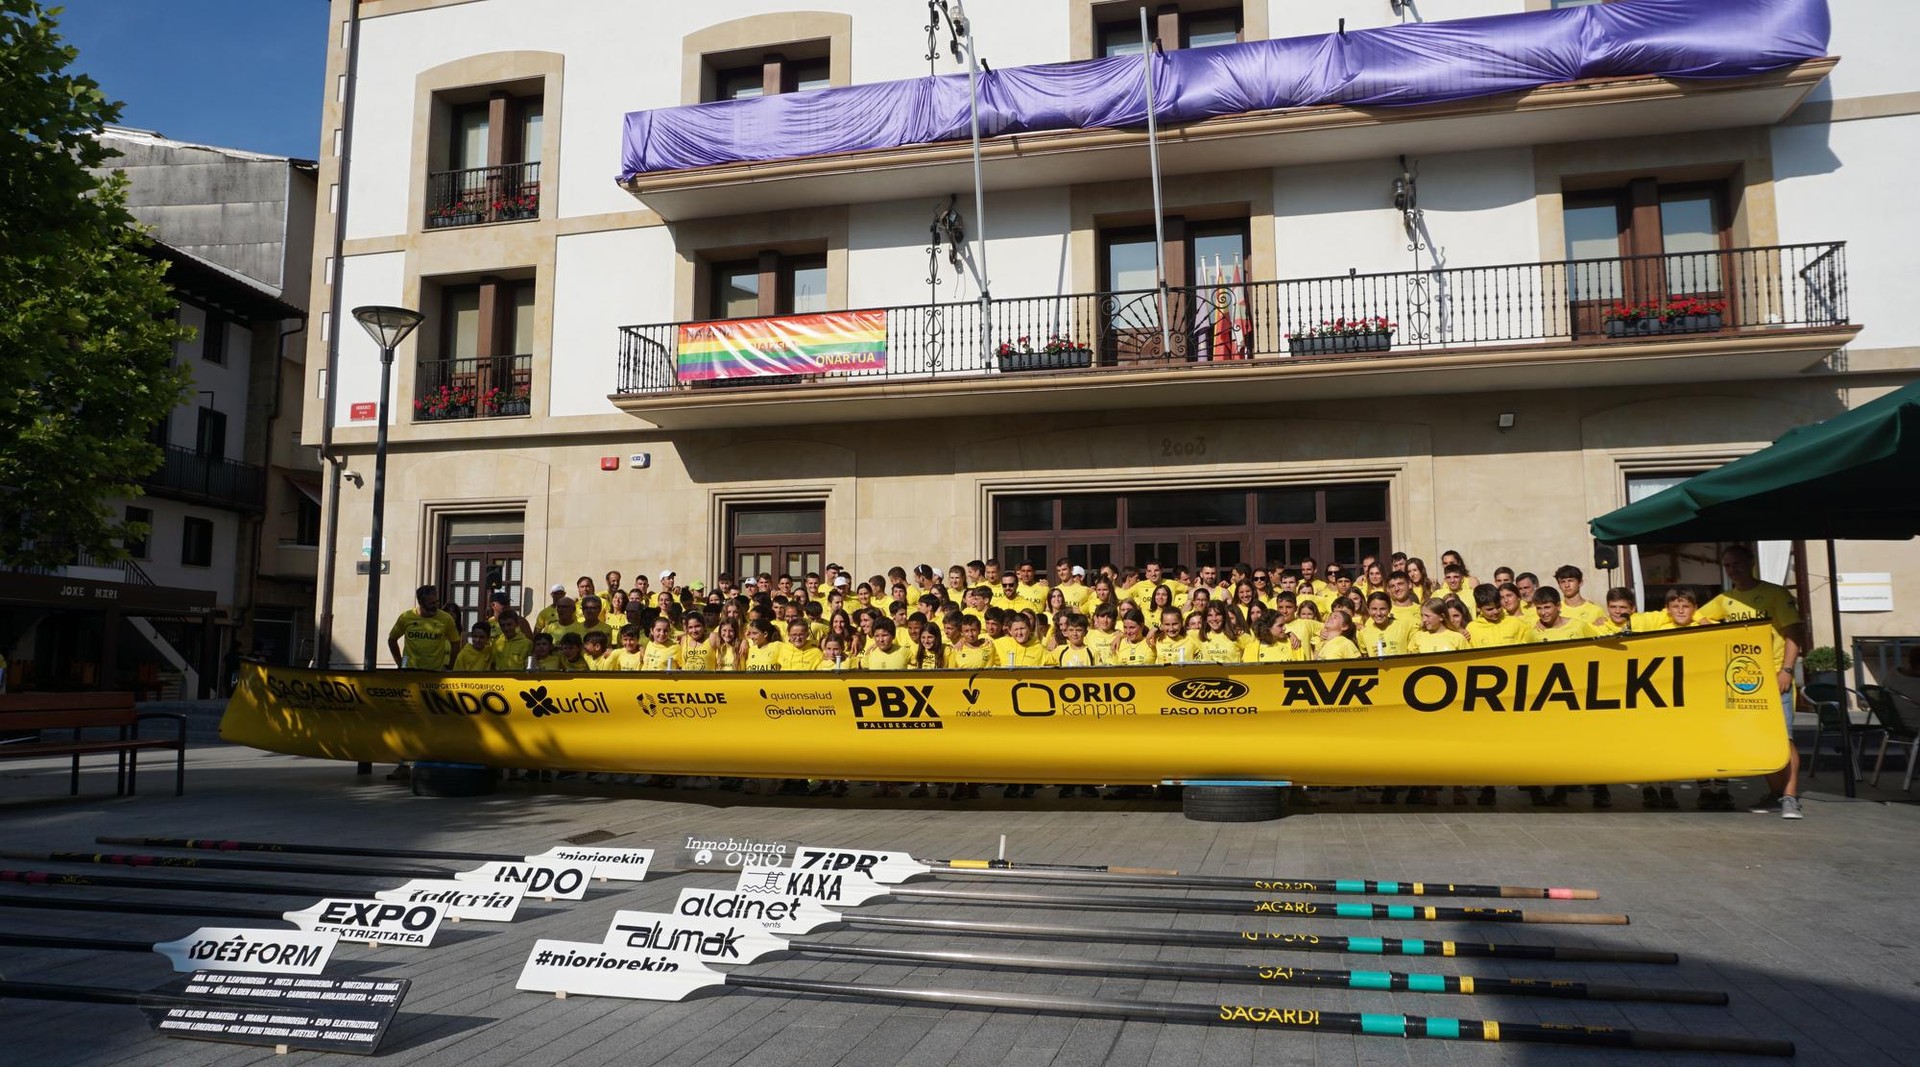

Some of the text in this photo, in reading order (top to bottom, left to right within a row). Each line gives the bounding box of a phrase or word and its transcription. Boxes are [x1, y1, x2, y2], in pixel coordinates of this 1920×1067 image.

[815, 352, 876, 366] ONARTUA
[60, 586, 86, 597] JOXE
[267, 675, 364, 704] SAGARDI
[1059, 682, 1136, 703] ORIO
[1181, 680, 1235, 700] Ford
[1281, 667, 1380, 706] AVK
[1402, 655, 1685, 713] ORIALKI
[419, 690, 512, 717] INDO
[657, 693, 728, 704] SETALDE
[848, 685, 941, 718] PBX
[661, 706, 718, 719] GROUP
[767, 706, 837, 717] mediolanum
[1062, 702, 1137, 719] kanpina
[1160, 706, 1258, 716] EASO MOTOR
[684, 836, 787, 854] Inmobiliaria
[725, 851, 783, 867] ORIO
[494, 866, 583, 894] INDO
[785, 872, 843, 901] KAXA
[318, 901, 437, 932] EXPO
[680, 893, 802, 921] aldinet
[616, 920, 746, 959] alumak
[535, 949, 680, 973] #nioriorekin
[1219, 1004, 1320, 1025] SAGARDI
